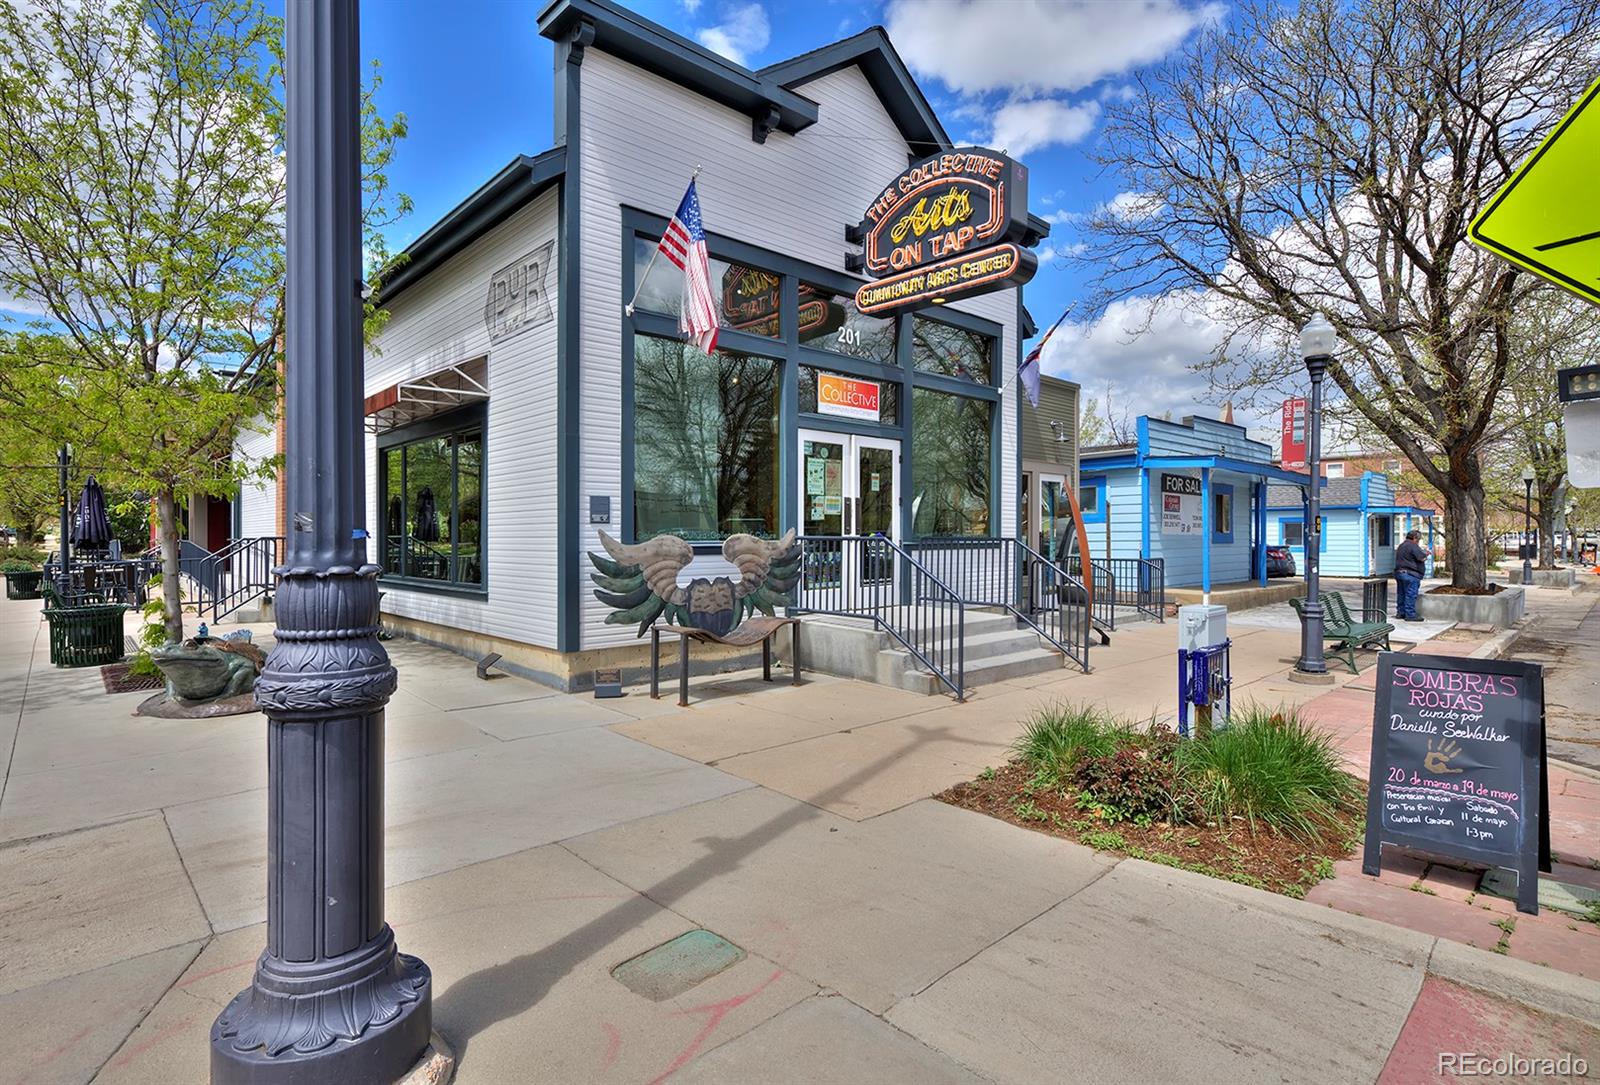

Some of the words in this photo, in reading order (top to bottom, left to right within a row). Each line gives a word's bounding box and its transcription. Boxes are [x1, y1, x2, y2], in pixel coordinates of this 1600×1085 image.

[866, 187, 899, 222] THE
[898, 153, 1004, 194] COLLECTIVE
[890, 241, 922, 270] ON
[928, 225, 974, 258] TAP
[837, 326, 861, 346] 201
[841, 381, 857, 392] THE
[1166, 476, 1184, 492] FOR
[1185, 479, 1202, 494] SAL
[1392, 667, 1518, 697] SOMBRAS
[1408, 689, 1484, 712] ROJAS
[1390, 714, 1438, 735] Danielle
[1419, 709, 1460, 721] curado
[1461, 712, 1483, 725] por
[1387, 767, 1406, 783] 20
[1410, 771, 1421, 785] de
[1423, 779, 1451, 790] marzo
[1461, 780, 1475, 794] 19
[1476, 784, 1489, 796] de
[1490, 790, 1519, 803] mayo
[1390, 813, 1421, 823] Cultural
[1438, 807, 1445, 816] y
[1461, 812, 1468, 821] 11
[1472, 815, 1483, 823] de
[1485, 817, 1509, 828] mayo
